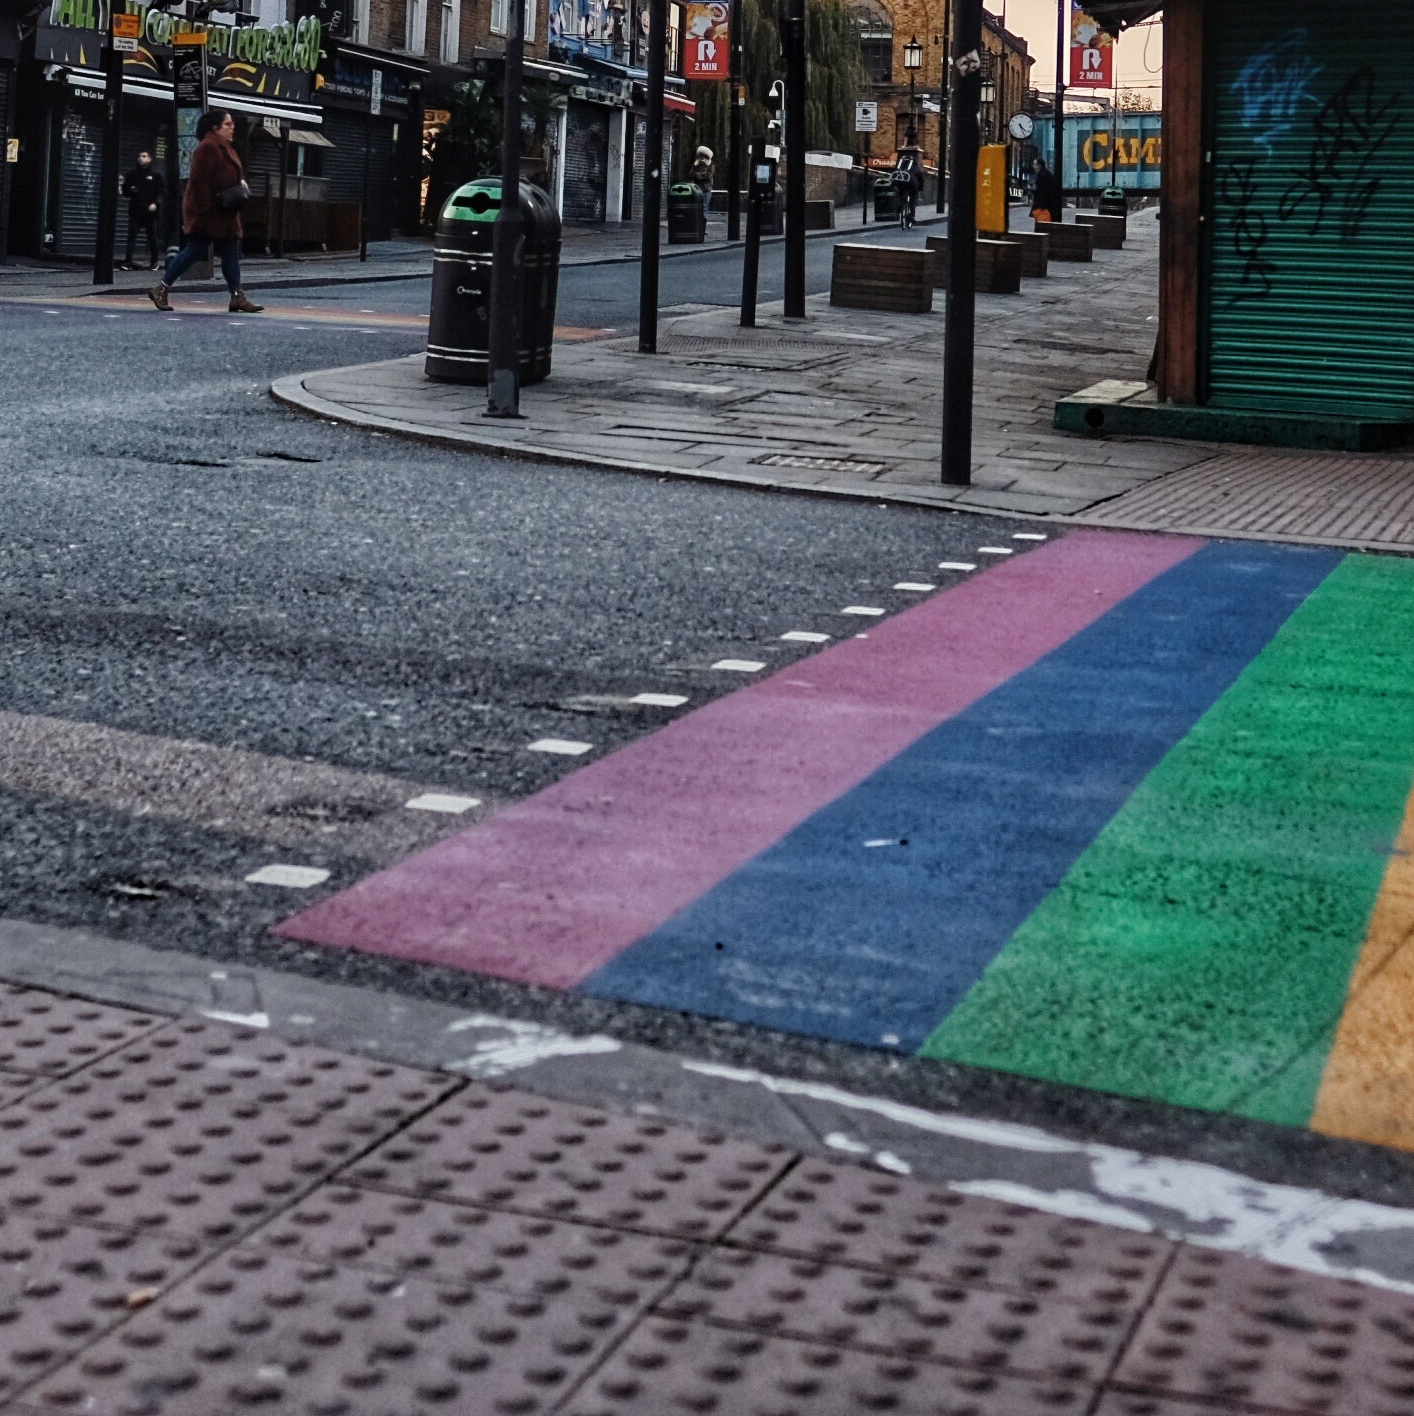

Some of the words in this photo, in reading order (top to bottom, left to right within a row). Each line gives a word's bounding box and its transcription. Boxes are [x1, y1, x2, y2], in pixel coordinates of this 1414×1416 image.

[694, 63, 700, 71] 2
[701, 62, 718, 71] MIN
[1079, 71, 1085, 80] 2
[1086, 71, 1103, 80] MIN
[1083, 132, 1161, 171] CAM
